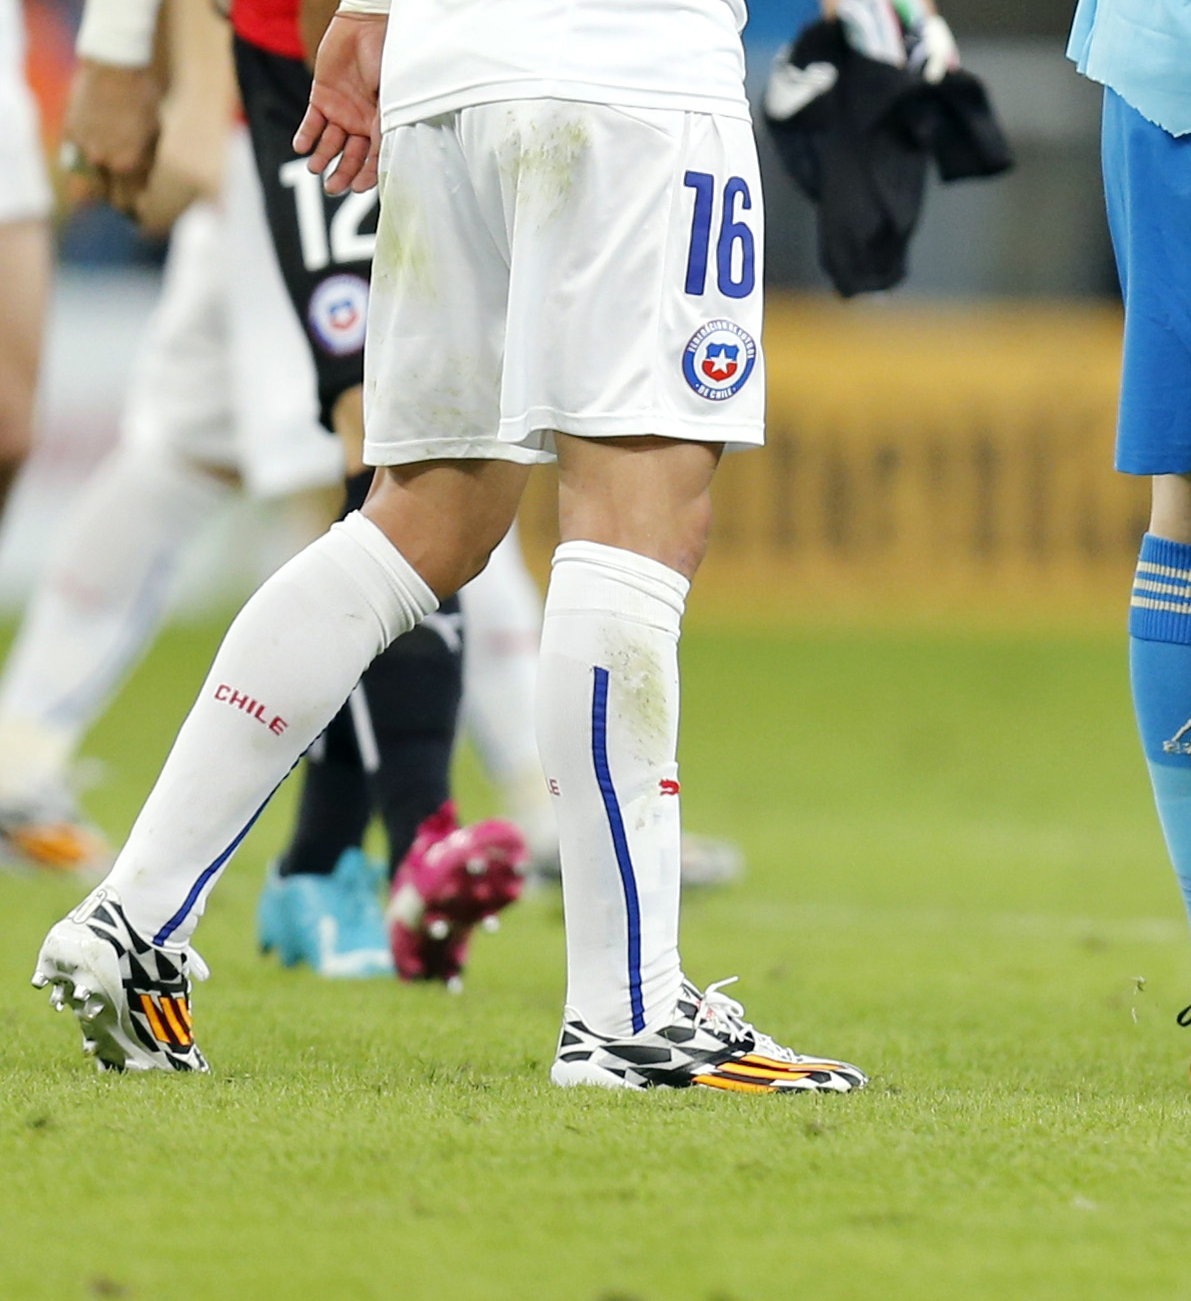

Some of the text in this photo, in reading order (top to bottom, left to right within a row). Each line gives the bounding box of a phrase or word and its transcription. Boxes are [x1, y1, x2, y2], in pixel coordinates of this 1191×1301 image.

[278, 152, 378, 272] 12
[683, 170, 755, 299] 16
[214, 684, 288, 736] CHILE
